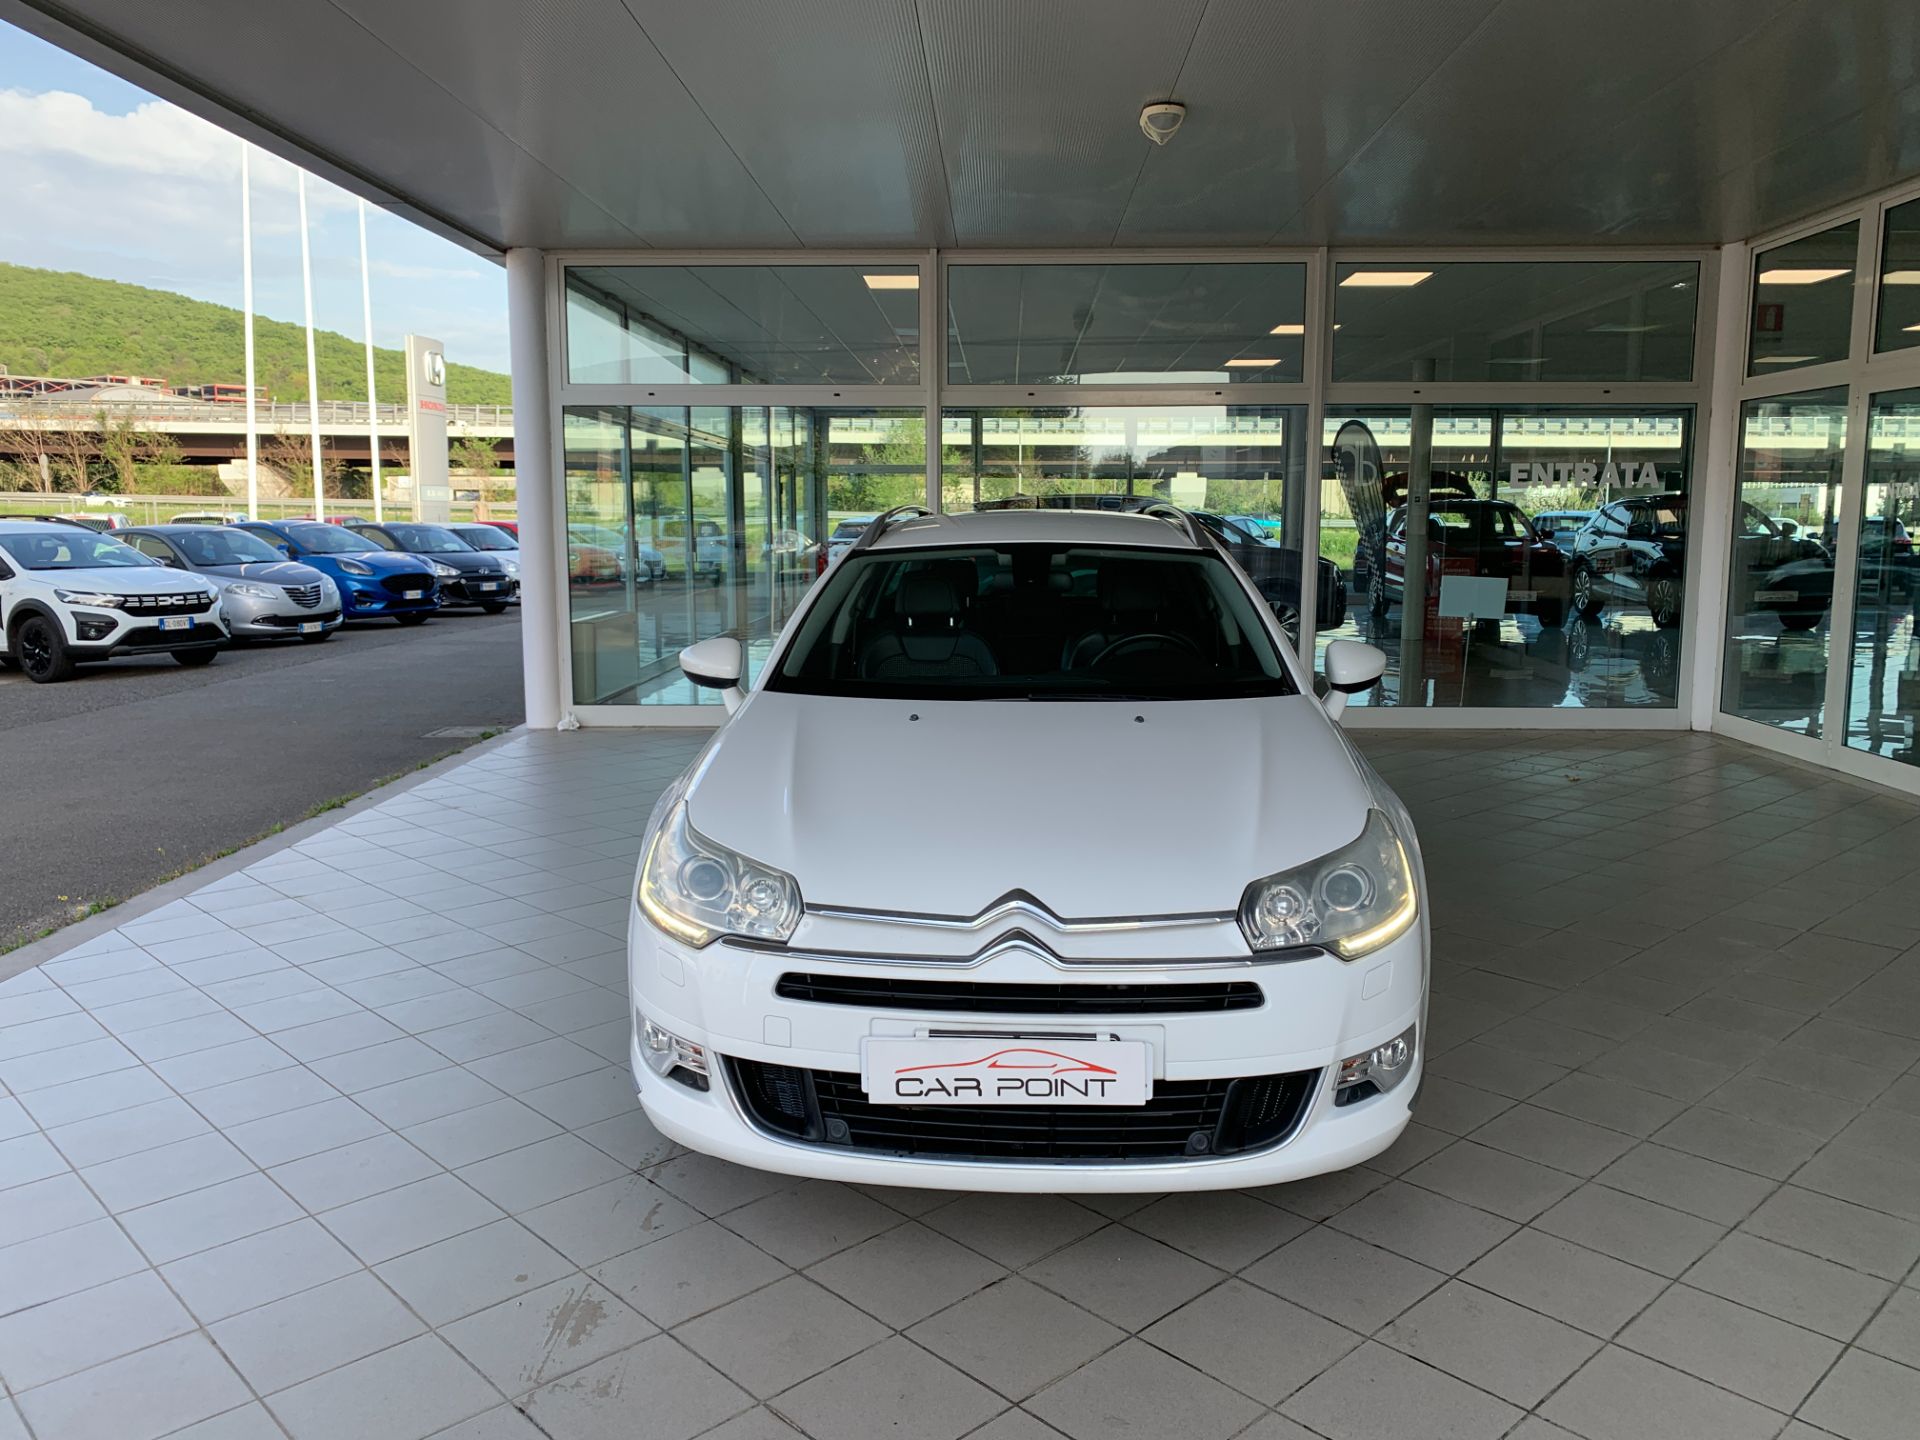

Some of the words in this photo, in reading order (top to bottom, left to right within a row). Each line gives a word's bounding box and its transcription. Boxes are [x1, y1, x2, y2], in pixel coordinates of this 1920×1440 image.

[1510, 462, 1659, 488] ENTRATA
[895, 1078, 983, 1097] CAR
[997, 1078, 1117, 1098] POINT
